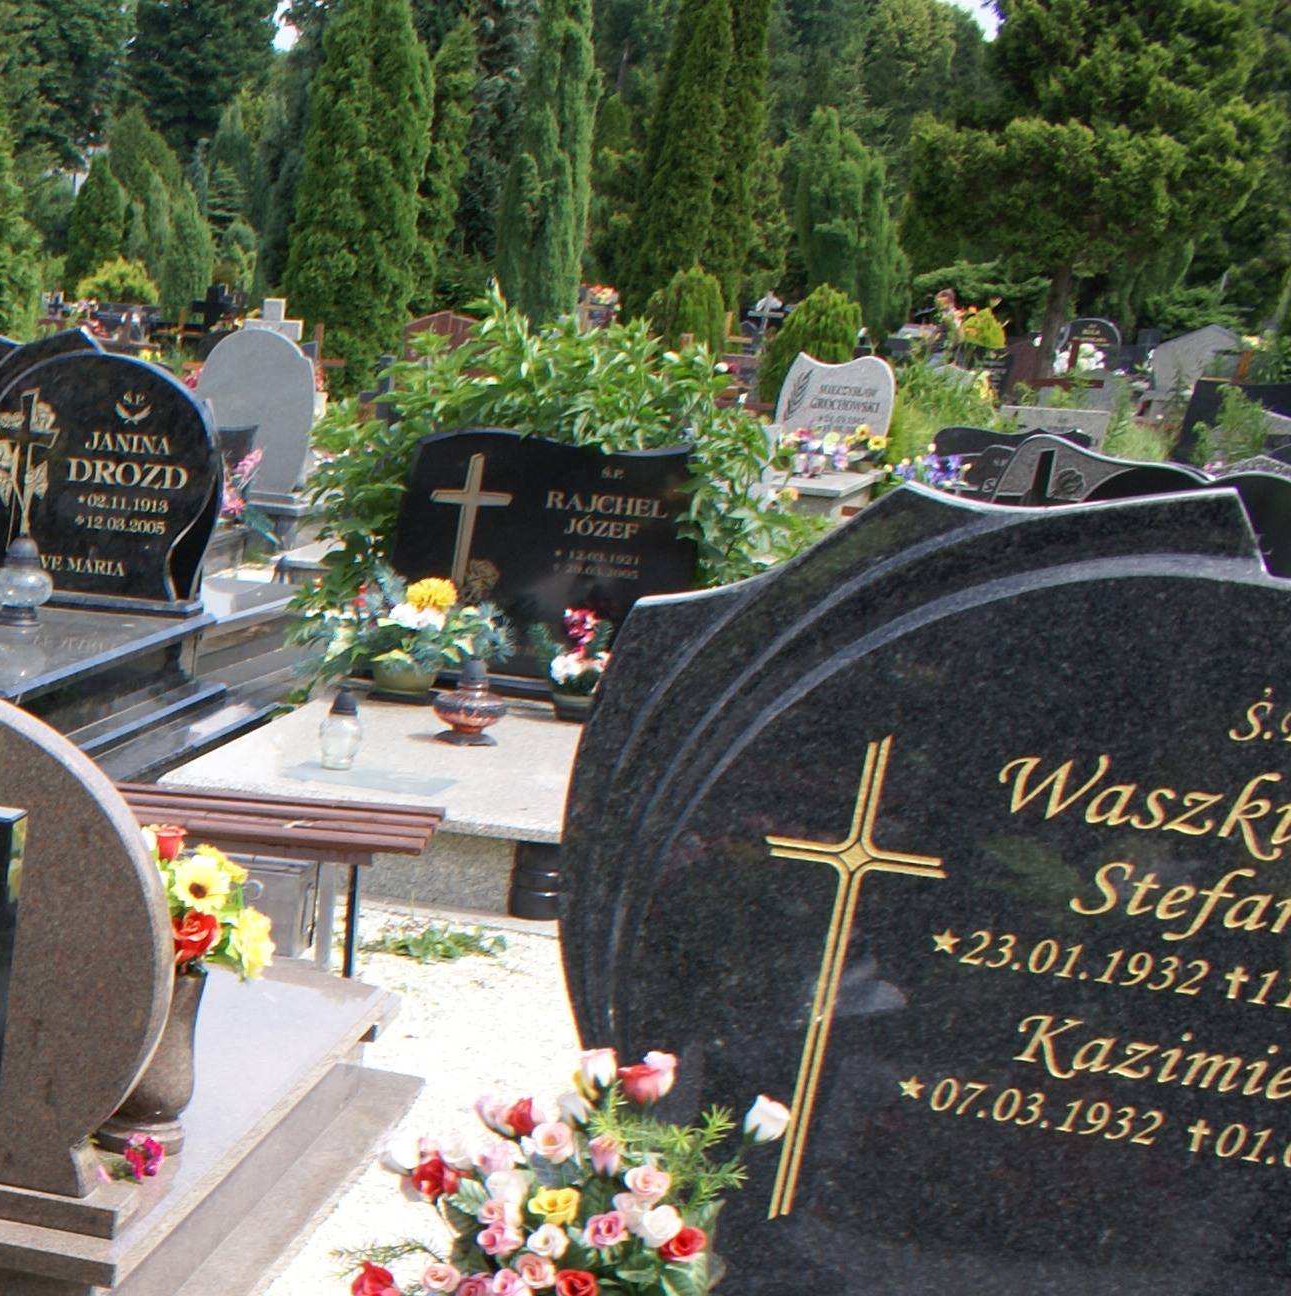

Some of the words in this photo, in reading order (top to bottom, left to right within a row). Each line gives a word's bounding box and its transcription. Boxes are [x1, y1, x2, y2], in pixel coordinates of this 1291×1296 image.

[809, 397, 880, 413] GROCHOWSKI
[85, 431, 170, 456] JANINA
[67, 457, 189, 490] DROZD
[545, 490, 668, 519] RAJCHEL
[563, 514, 640, 540] JÓZEF
[39, 554, 62, 572] VE
[68, 556, 125, 577] MARIA
[959, 930, 1210, 996] 23.01.1932
[930, 1077, 1165, 1146] 07.03.1932
